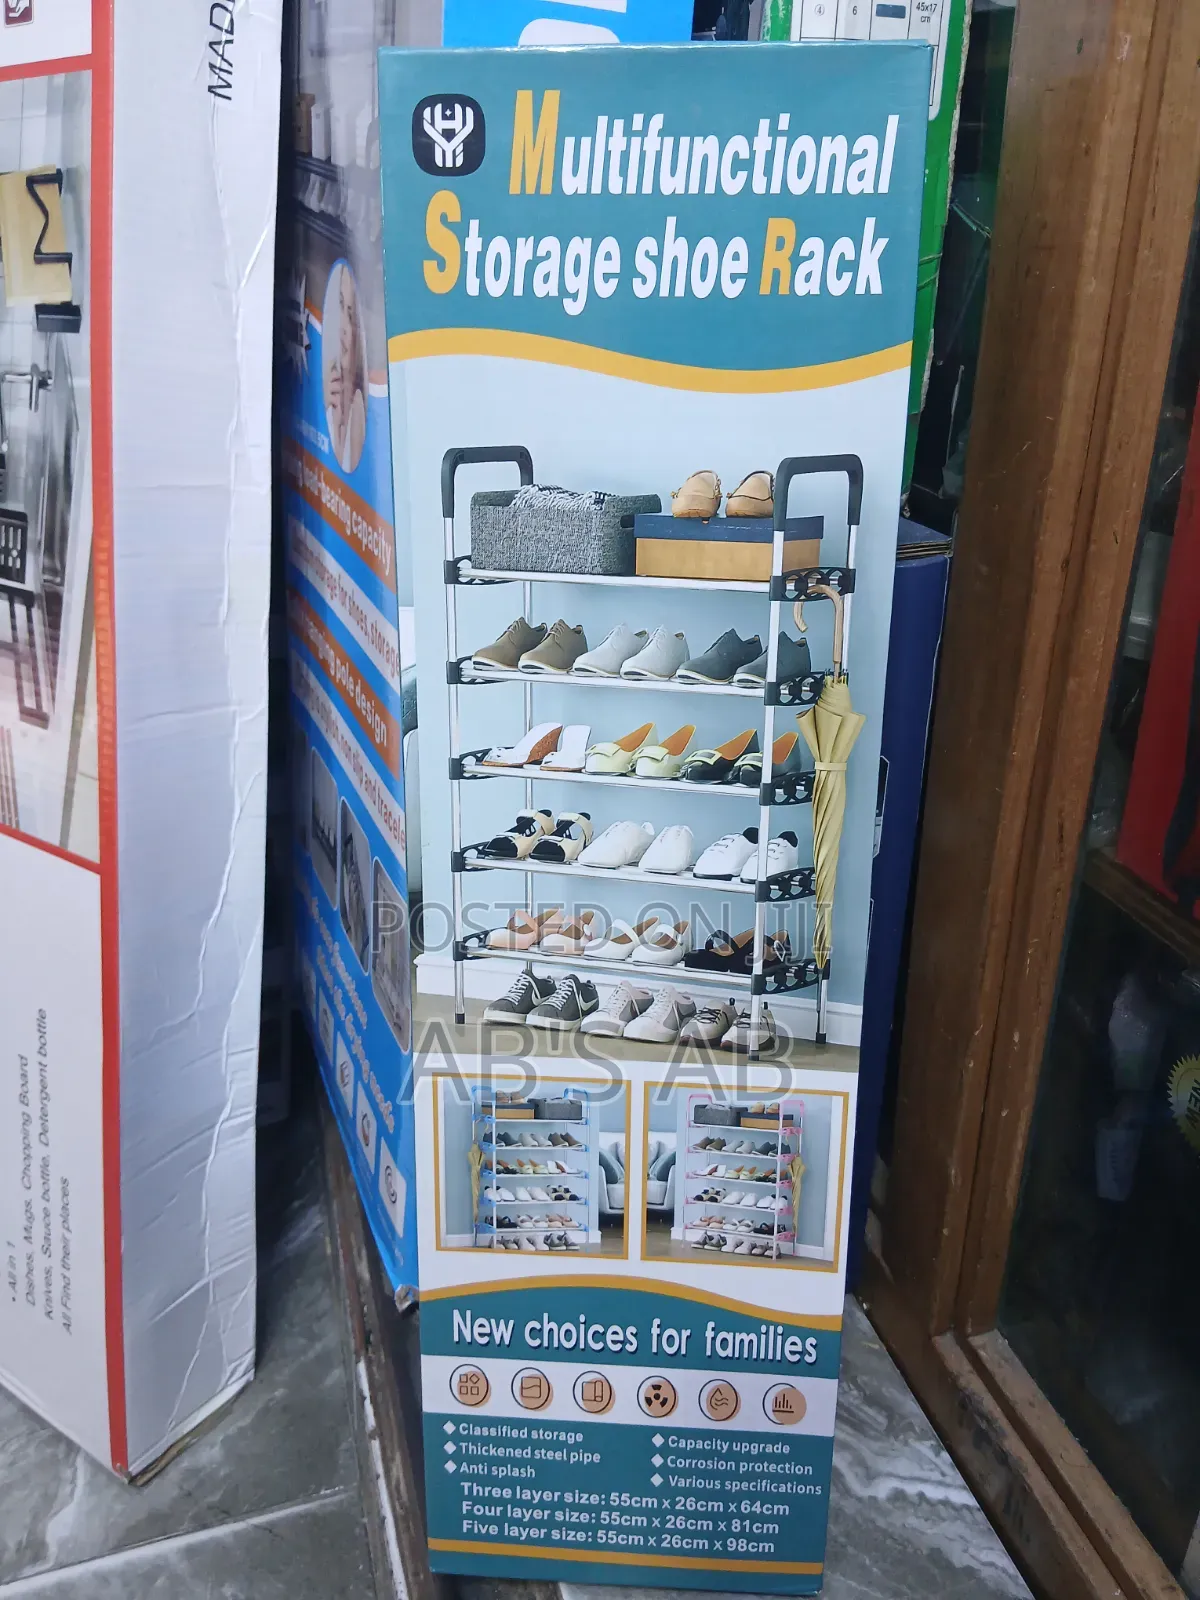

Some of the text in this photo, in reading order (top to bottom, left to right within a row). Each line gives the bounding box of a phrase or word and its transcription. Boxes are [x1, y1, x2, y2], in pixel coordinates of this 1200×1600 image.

[208, 0, 235, 101] MAD
[509, 90, 899, 195] Multifunctional
[423, 190, 889, 315] Storage shoe Rack
[352, 511, 391, 576] capacity
[335, 655, 354, 697] pole
[355, 679, 387, 747] design
[36, 1008, 48, 1057] bottle
[17, 1054, 30, 1107] Board
[38, 1061, 51, 1147] Detergent
[20, 1111, 33, 1190] Chopping
[59, 1176, 72, 1233] places
[41, 1206, 52, 1258] Sauce
[453, 1309, 818, 1365] New choices for families
[459, 1423, 584, 1444] Classified storage
[459, 1442, 601, 1465] Thickened steel pipe
[668, 1436, 790, 1455] Capacity upgrade
[460, 1462, 536, 1478] Anti splash
[667, 1456, 813, 1475] Corrosion protection
[669, 1475, 822, 1495] Various specifications
[461, 1482, 790, 1516] Three layer size: 55cm x 26cm x 64cm
[462, 1501, 779, 1534] Four layer size: 55cm x 26cm x 81cm
[462, 1519, 775, 1553] Five layer size: 55cm x 26cm x 98cm
